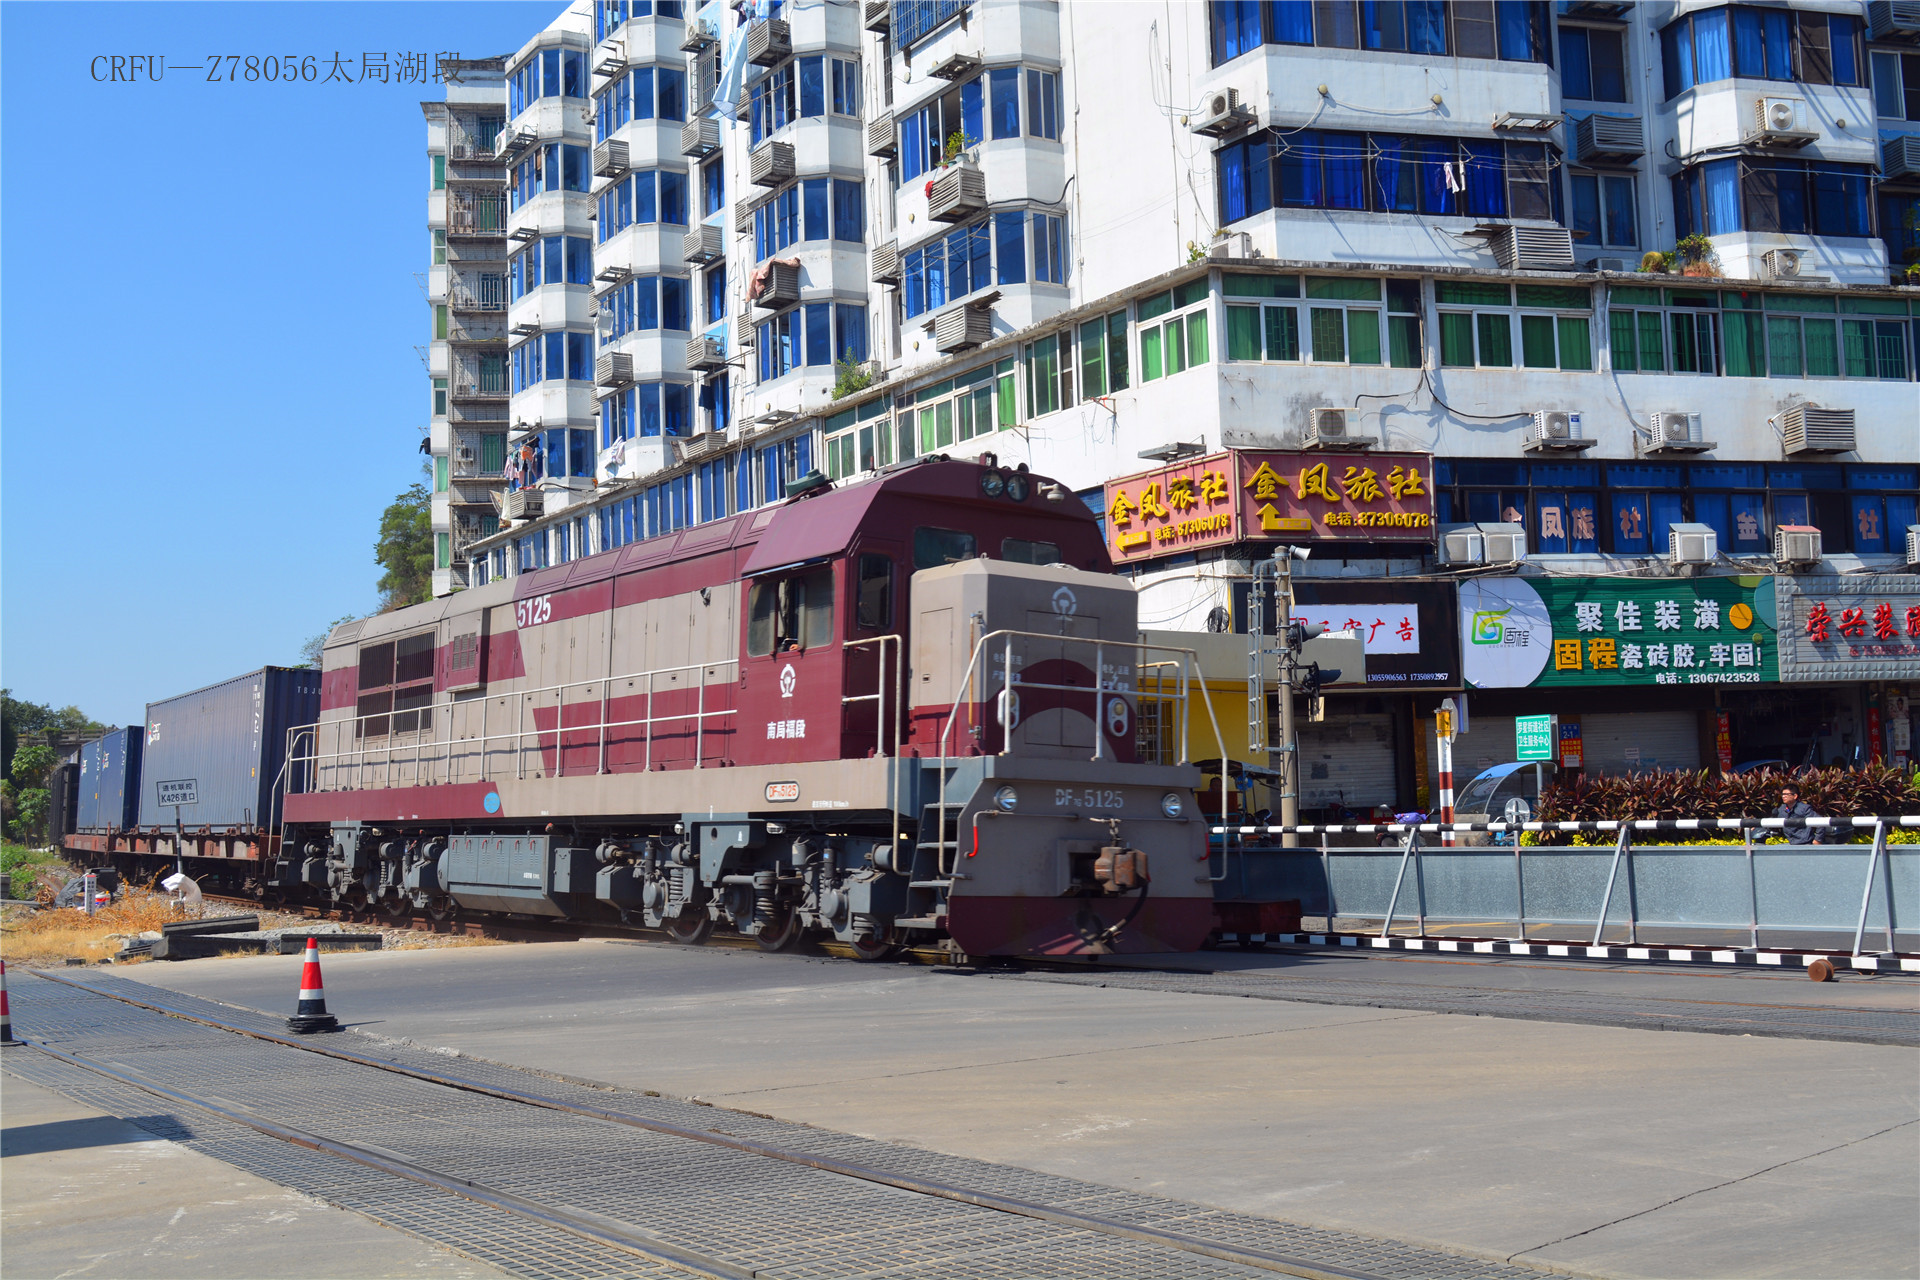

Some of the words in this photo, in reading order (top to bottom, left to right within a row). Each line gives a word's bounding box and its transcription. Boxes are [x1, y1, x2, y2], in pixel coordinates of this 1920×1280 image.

[1244, 461, 1426, 502] 金凤旅社
[1108, 470, 1229, 526] 金凤旅社
[517, 593, 552, 628] 5125
[1574, 599, 1720, 632] 聚佳装潢
[767, 719, 806, 740] 南局福段
[1518, 734, 1550, 748] 卫生服务中心
[161, 792, 195, 803] K426道口
[1084, 789, 1124, 809] 5125
